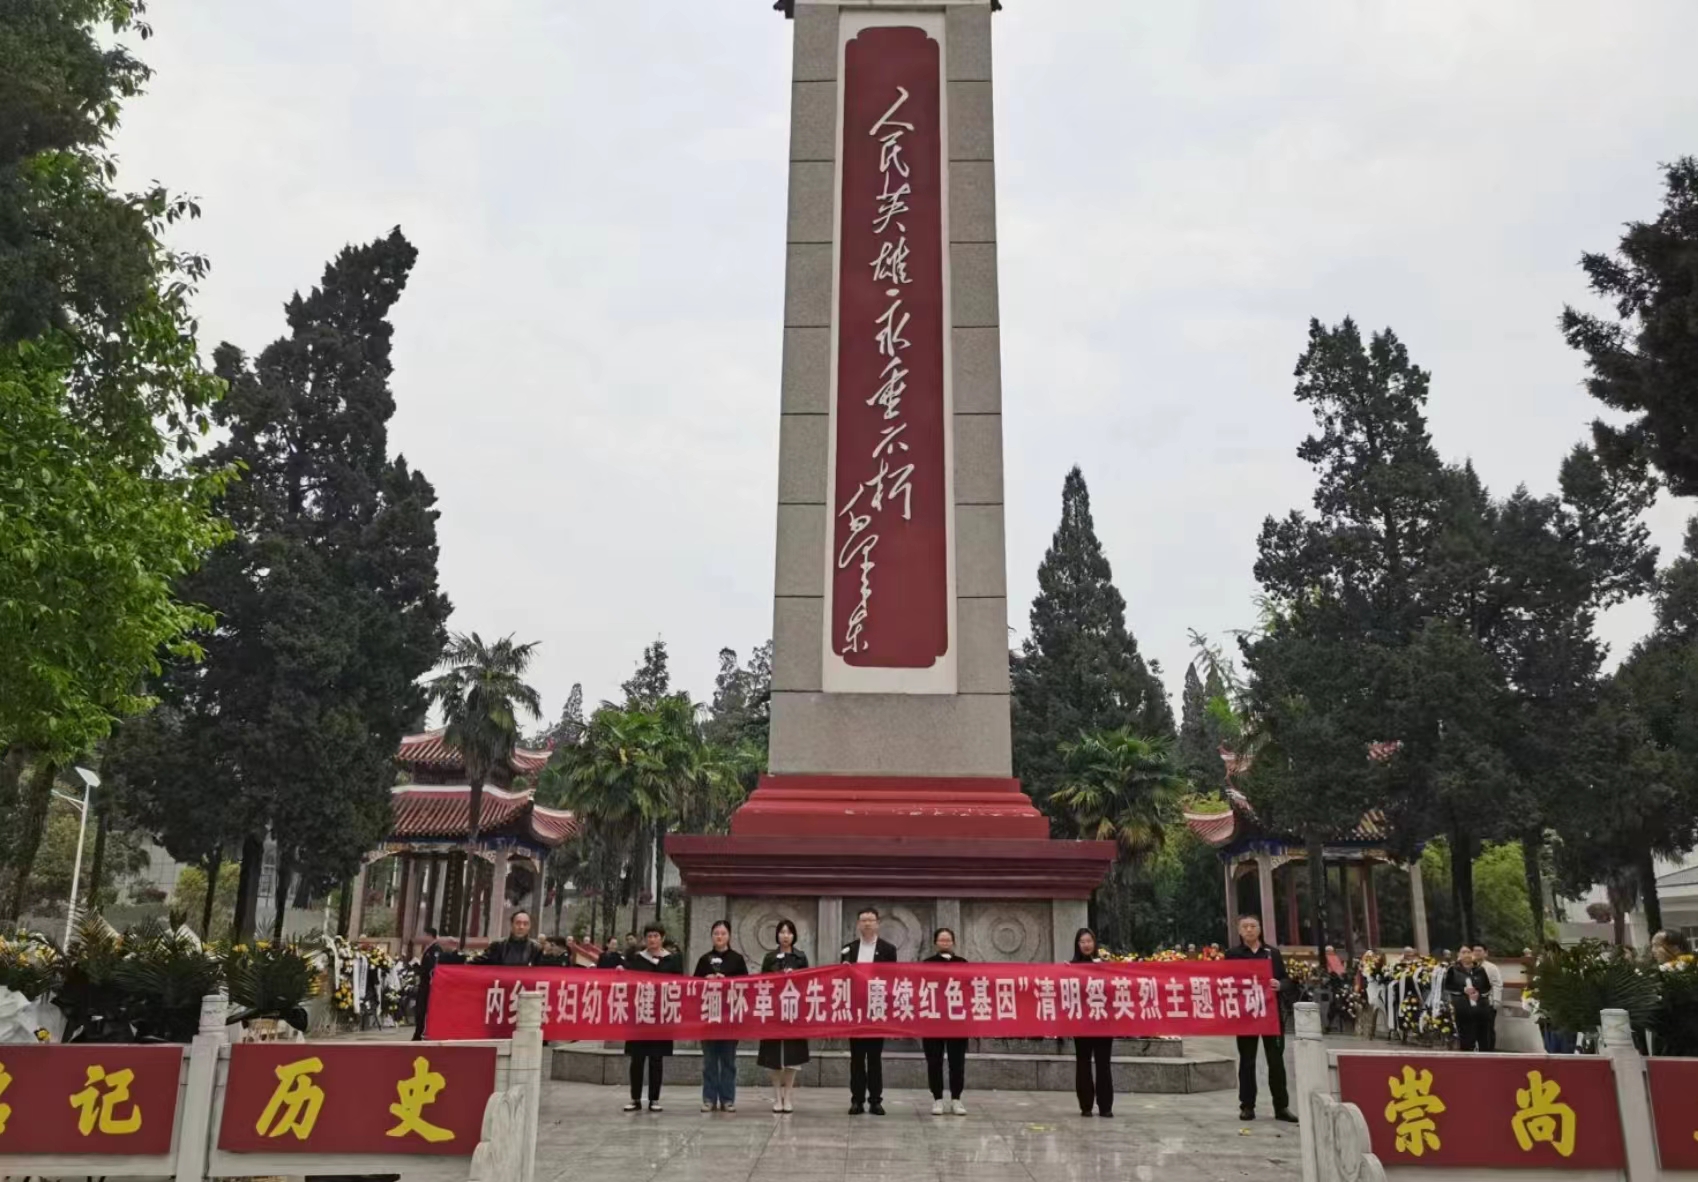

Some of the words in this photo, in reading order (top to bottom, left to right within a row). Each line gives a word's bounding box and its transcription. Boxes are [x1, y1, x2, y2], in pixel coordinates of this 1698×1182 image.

[865, 86, 915, 520] 人民英雄永垂不朽
[0, 1062, 142, 1136] 记
[256, 1056, 456, 1143] 历史
[1384, 1065, 1576, 1157] 崇尚
